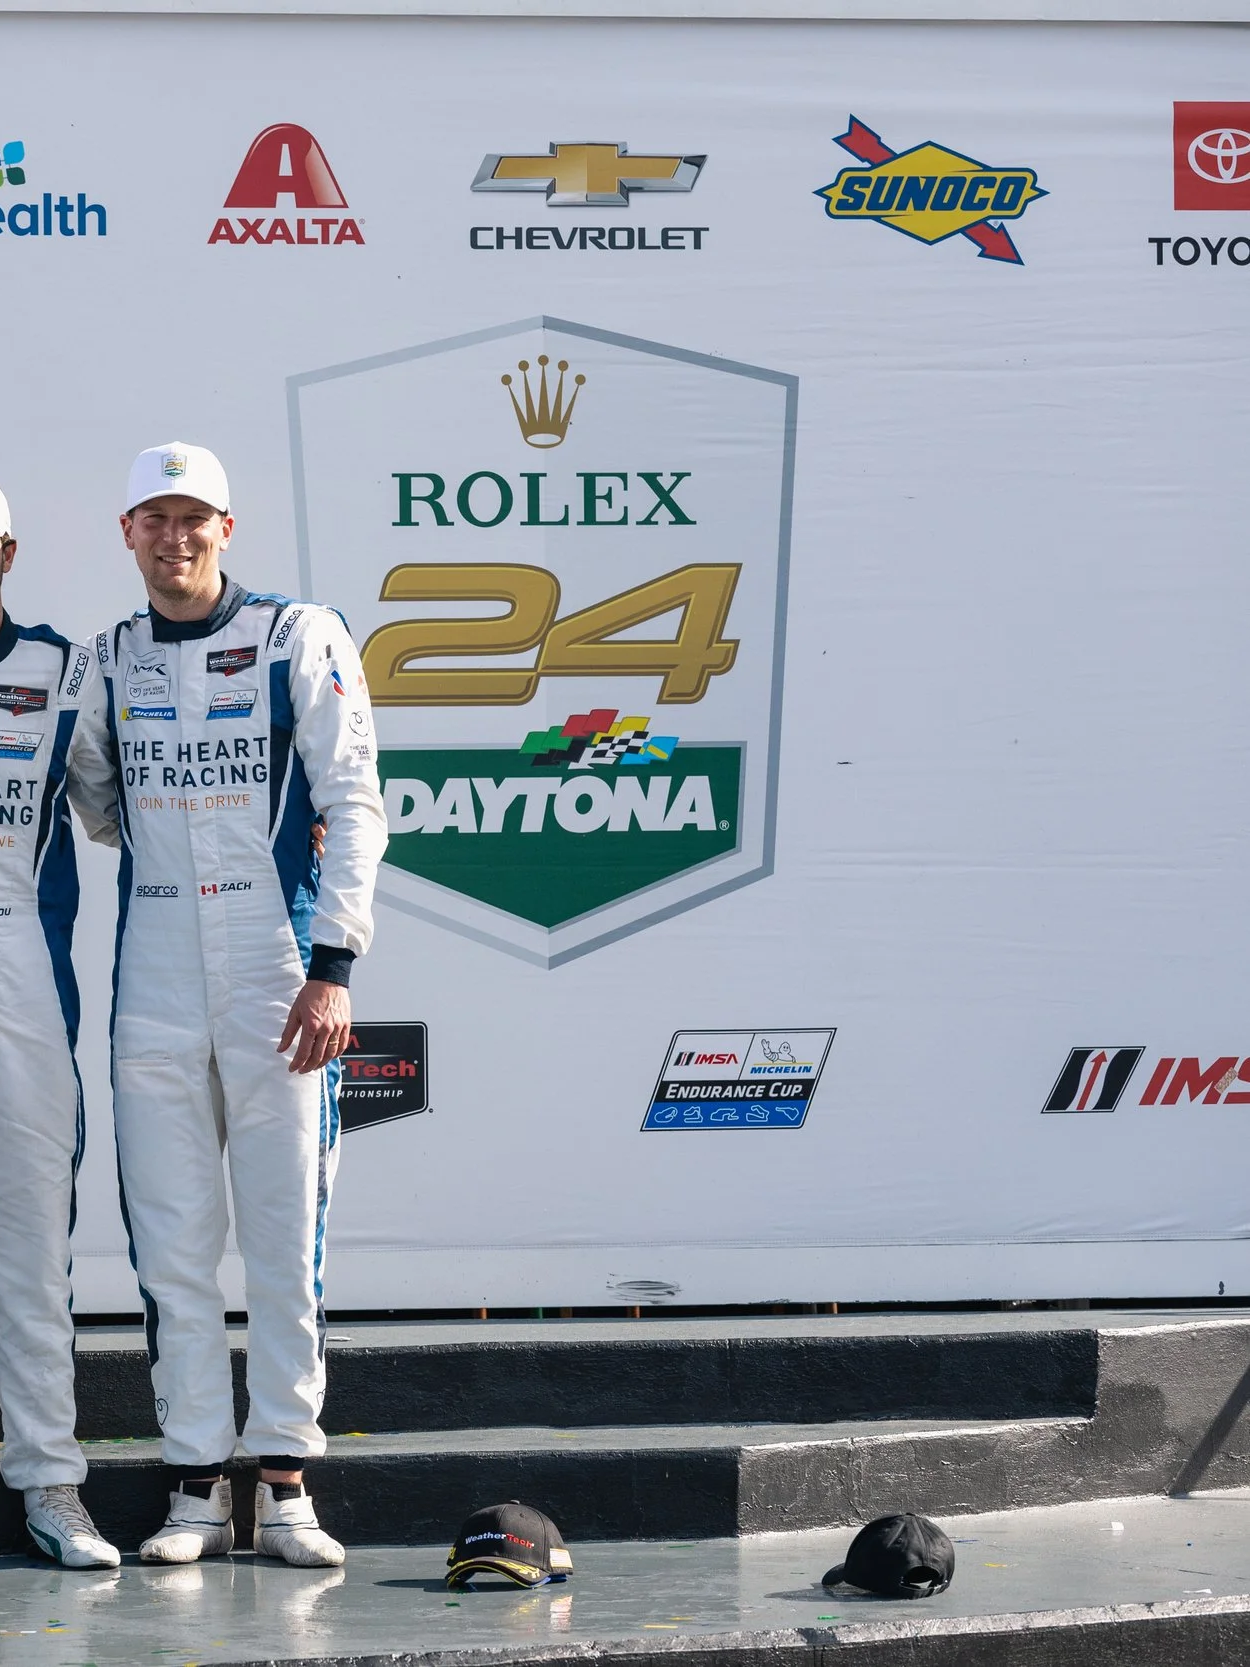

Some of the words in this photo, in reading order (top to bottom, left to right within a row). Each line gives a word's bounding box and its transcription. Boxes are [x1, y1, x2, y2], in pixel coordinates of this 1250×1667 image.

[835, 175, 1027, 212] SUNOCO
[207, 218, 366, 245] AXALTA
[469, 226, 709, 251] CHEVROLET
[1148, 236, 1250, 266] TOYO
[391, 471, 697, 528] ROLEX
[274, 608, 302, 649] sparco
[361, 562, 743, 707] 24
[67, 652, 89, 697] sparco
[122, 739, 164, 762] THE
[177, 736, 268, 764] HEART
[126, 766, 150, 787] OF
[162, 762, 268, 788] RACING
[168, 797, 198, 811] THE
[205, 794, 250, 809] DRIVE
[385, 775, 717, 834] DAYTONA
[136, 885, 178, 897] sparco
[220, 881, 252, 892] ZACH
[695, 1054, 738, 1065] IMSA
[750, 1065, 812, 1074] MICHELIN
[665, 1083, 766, 1099] ENDURANCE
[768, 1082, 803, 1097] CUP
[465, 1531, 535, 1549] WeatherTech
